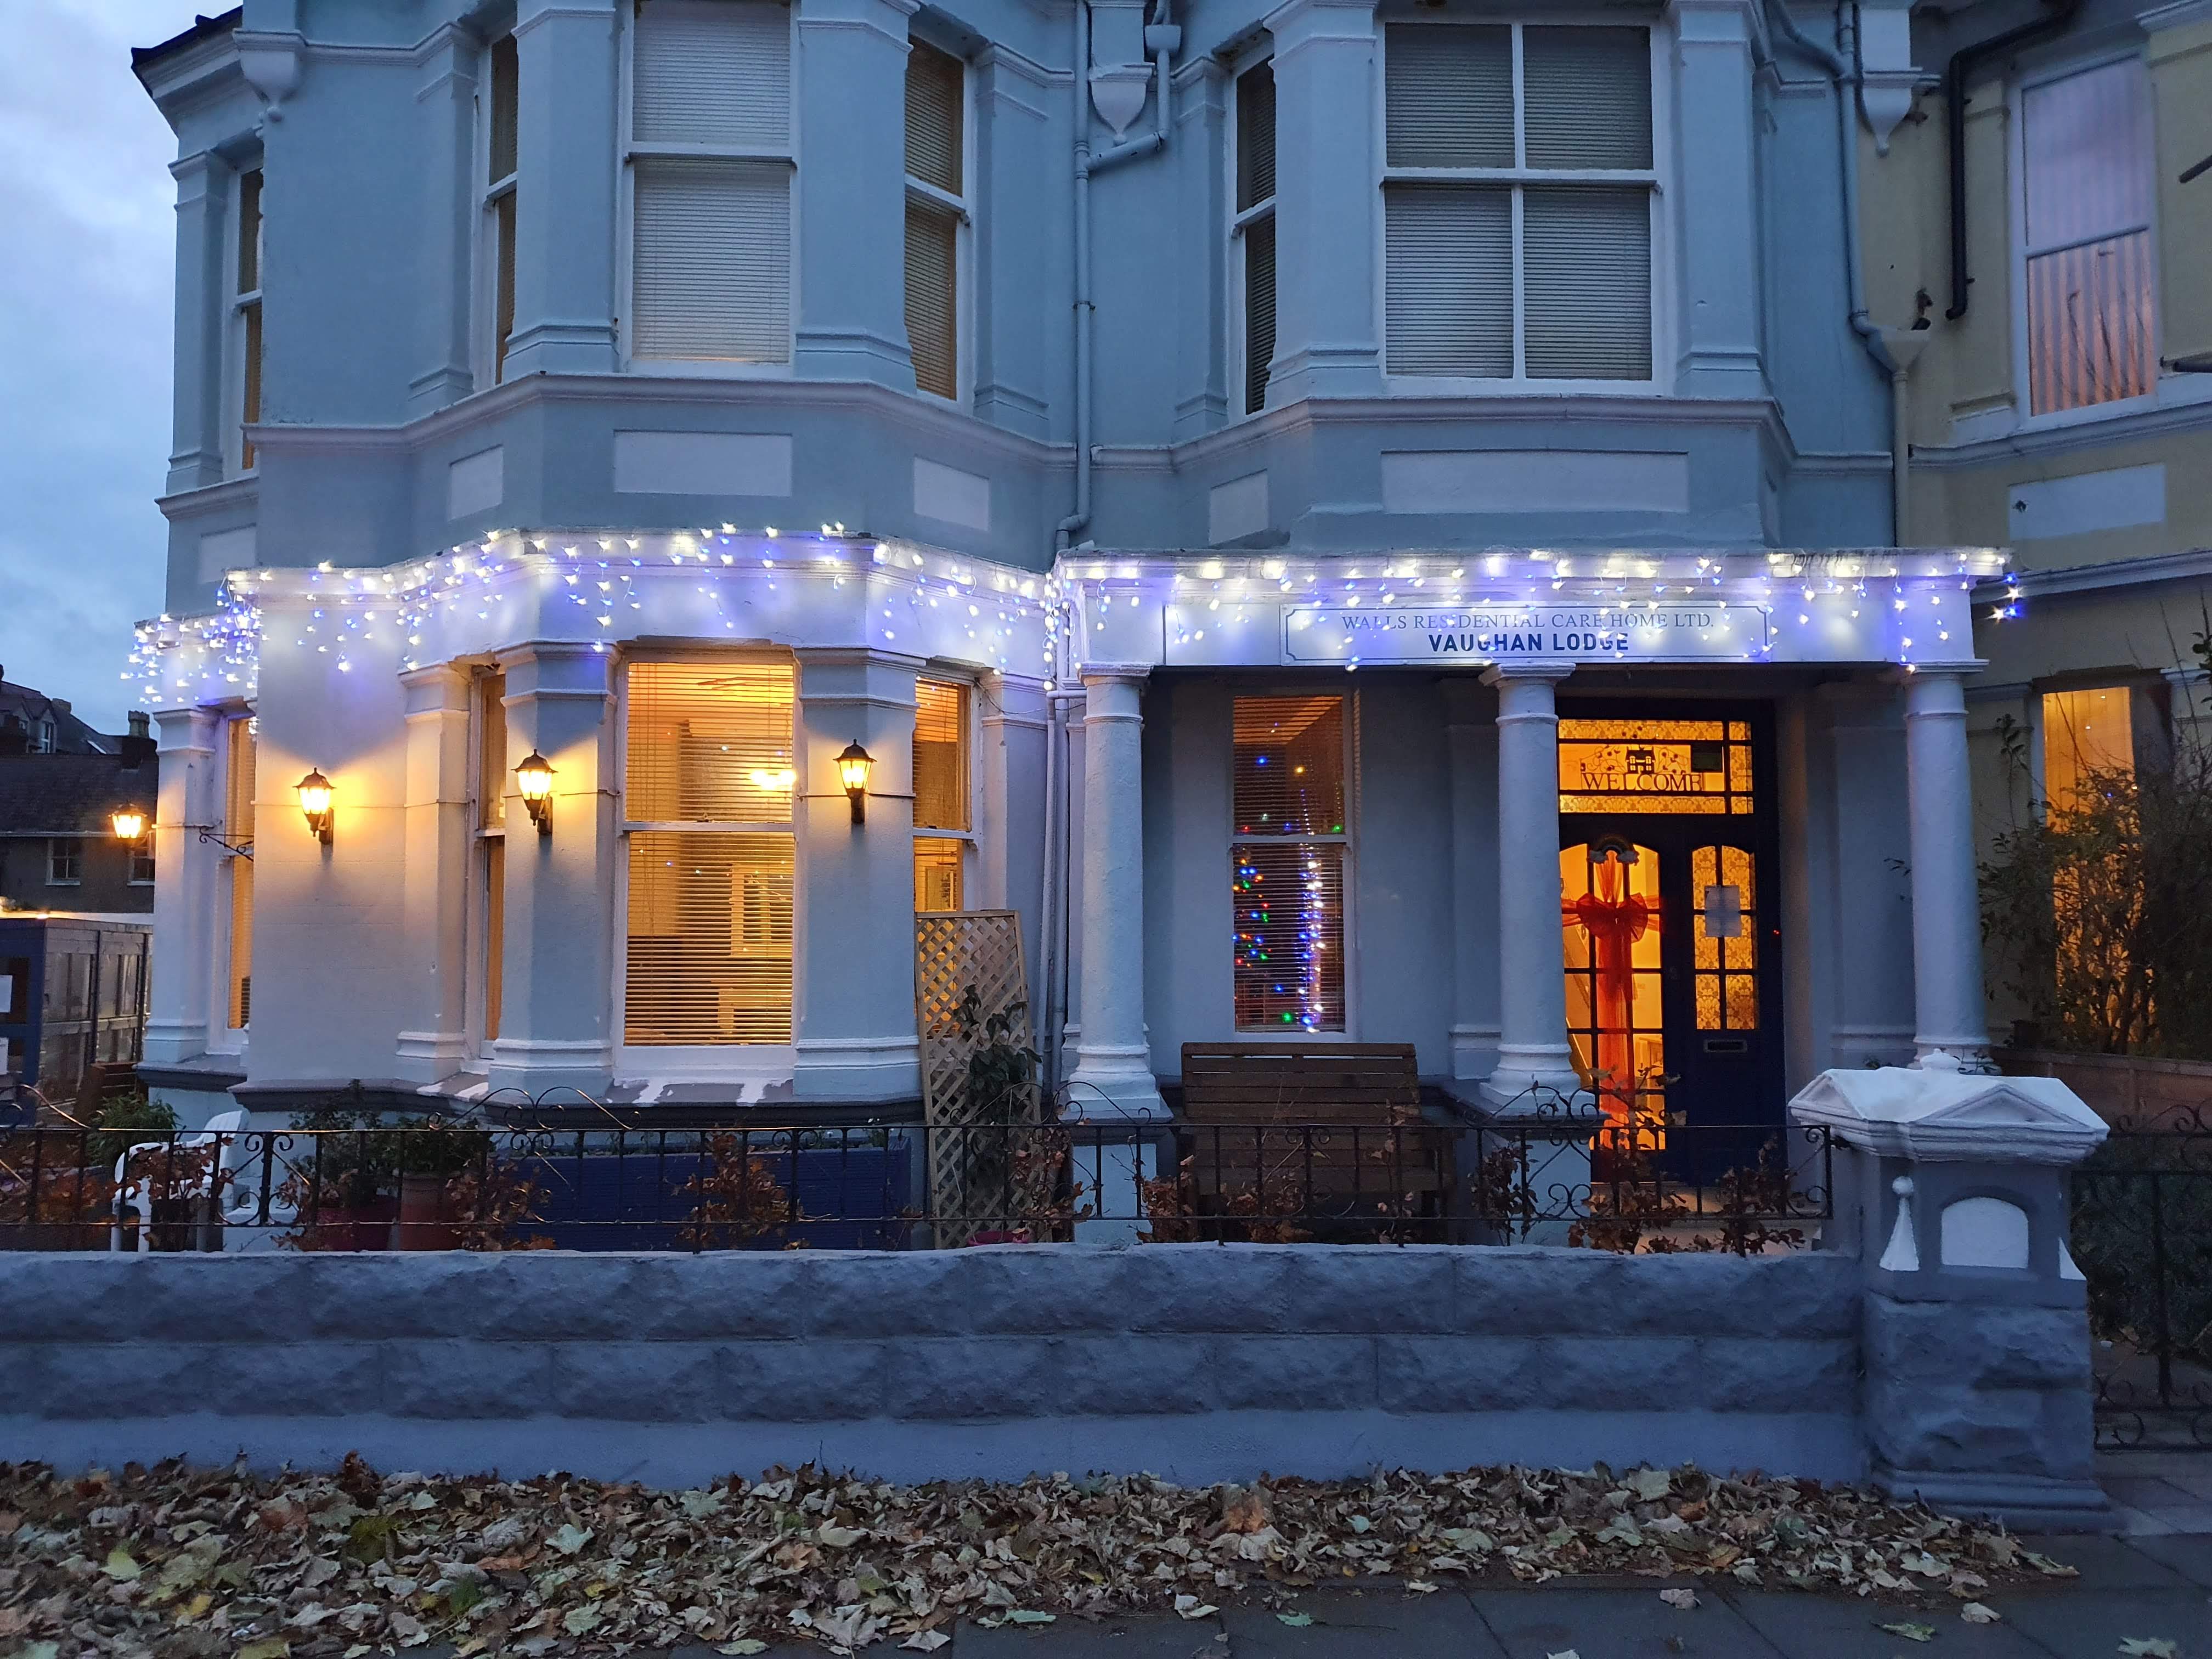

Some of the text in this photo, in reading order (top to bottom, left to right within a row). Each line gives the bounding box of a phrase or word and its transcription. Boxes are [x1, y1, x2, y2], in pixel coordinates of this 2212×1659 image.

[1552, 614, 1602, 628] CARE
[1612, 614, 1667, 627] HOME
[1674, 614, 1714, 627] LTD.
[1429, 633, 1629, 652] VAUGHAN LODGE
[1582, 773, 1702, 791] WELCOME
